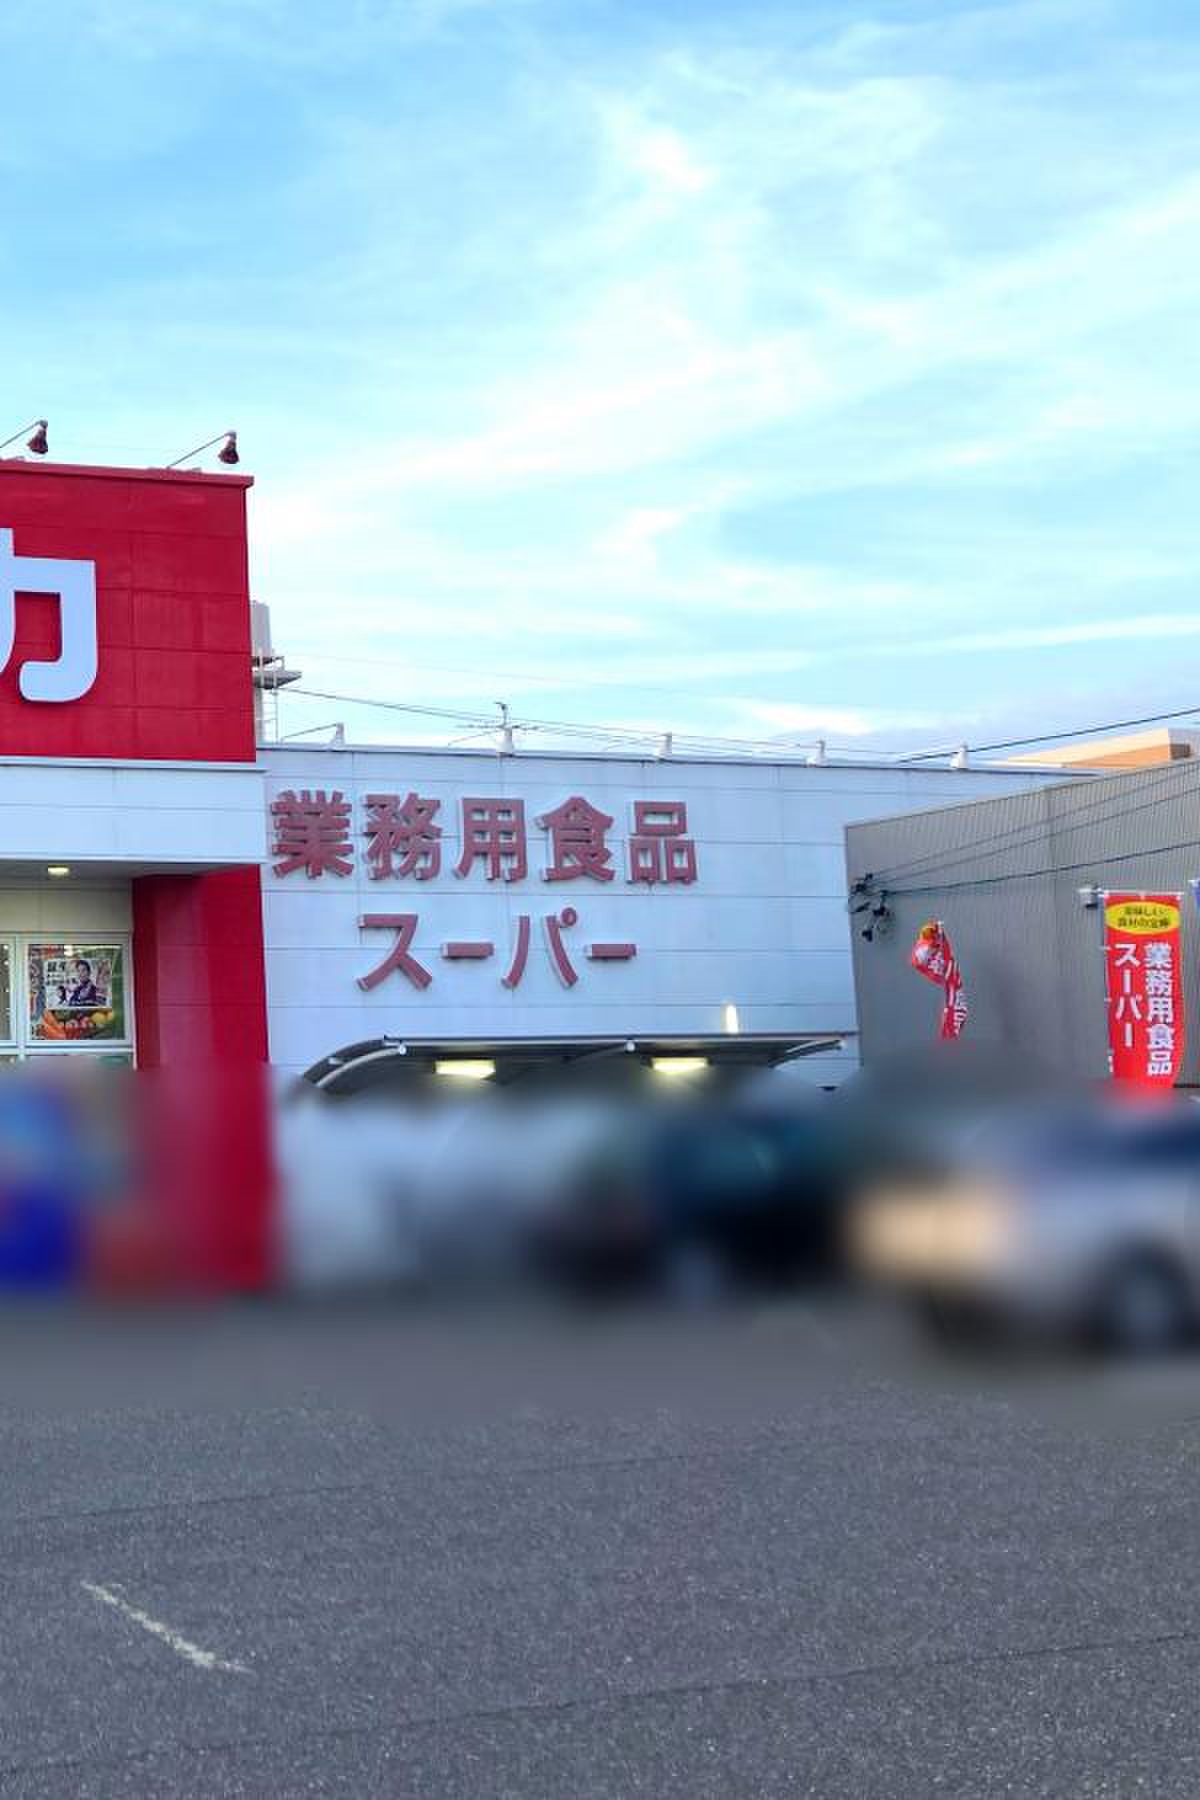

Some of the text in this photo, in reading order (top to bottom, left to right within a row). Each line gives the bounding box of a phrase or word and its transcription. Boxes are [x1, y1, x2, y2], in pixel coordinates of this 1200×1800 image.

[270, 790, 698, 885] 業務用食品
[356, 906, 638, 992] スーパー
[1114, 943, 1141, 1048] スーパー
[1143, 941, 1174, 1077] 業務用食品
